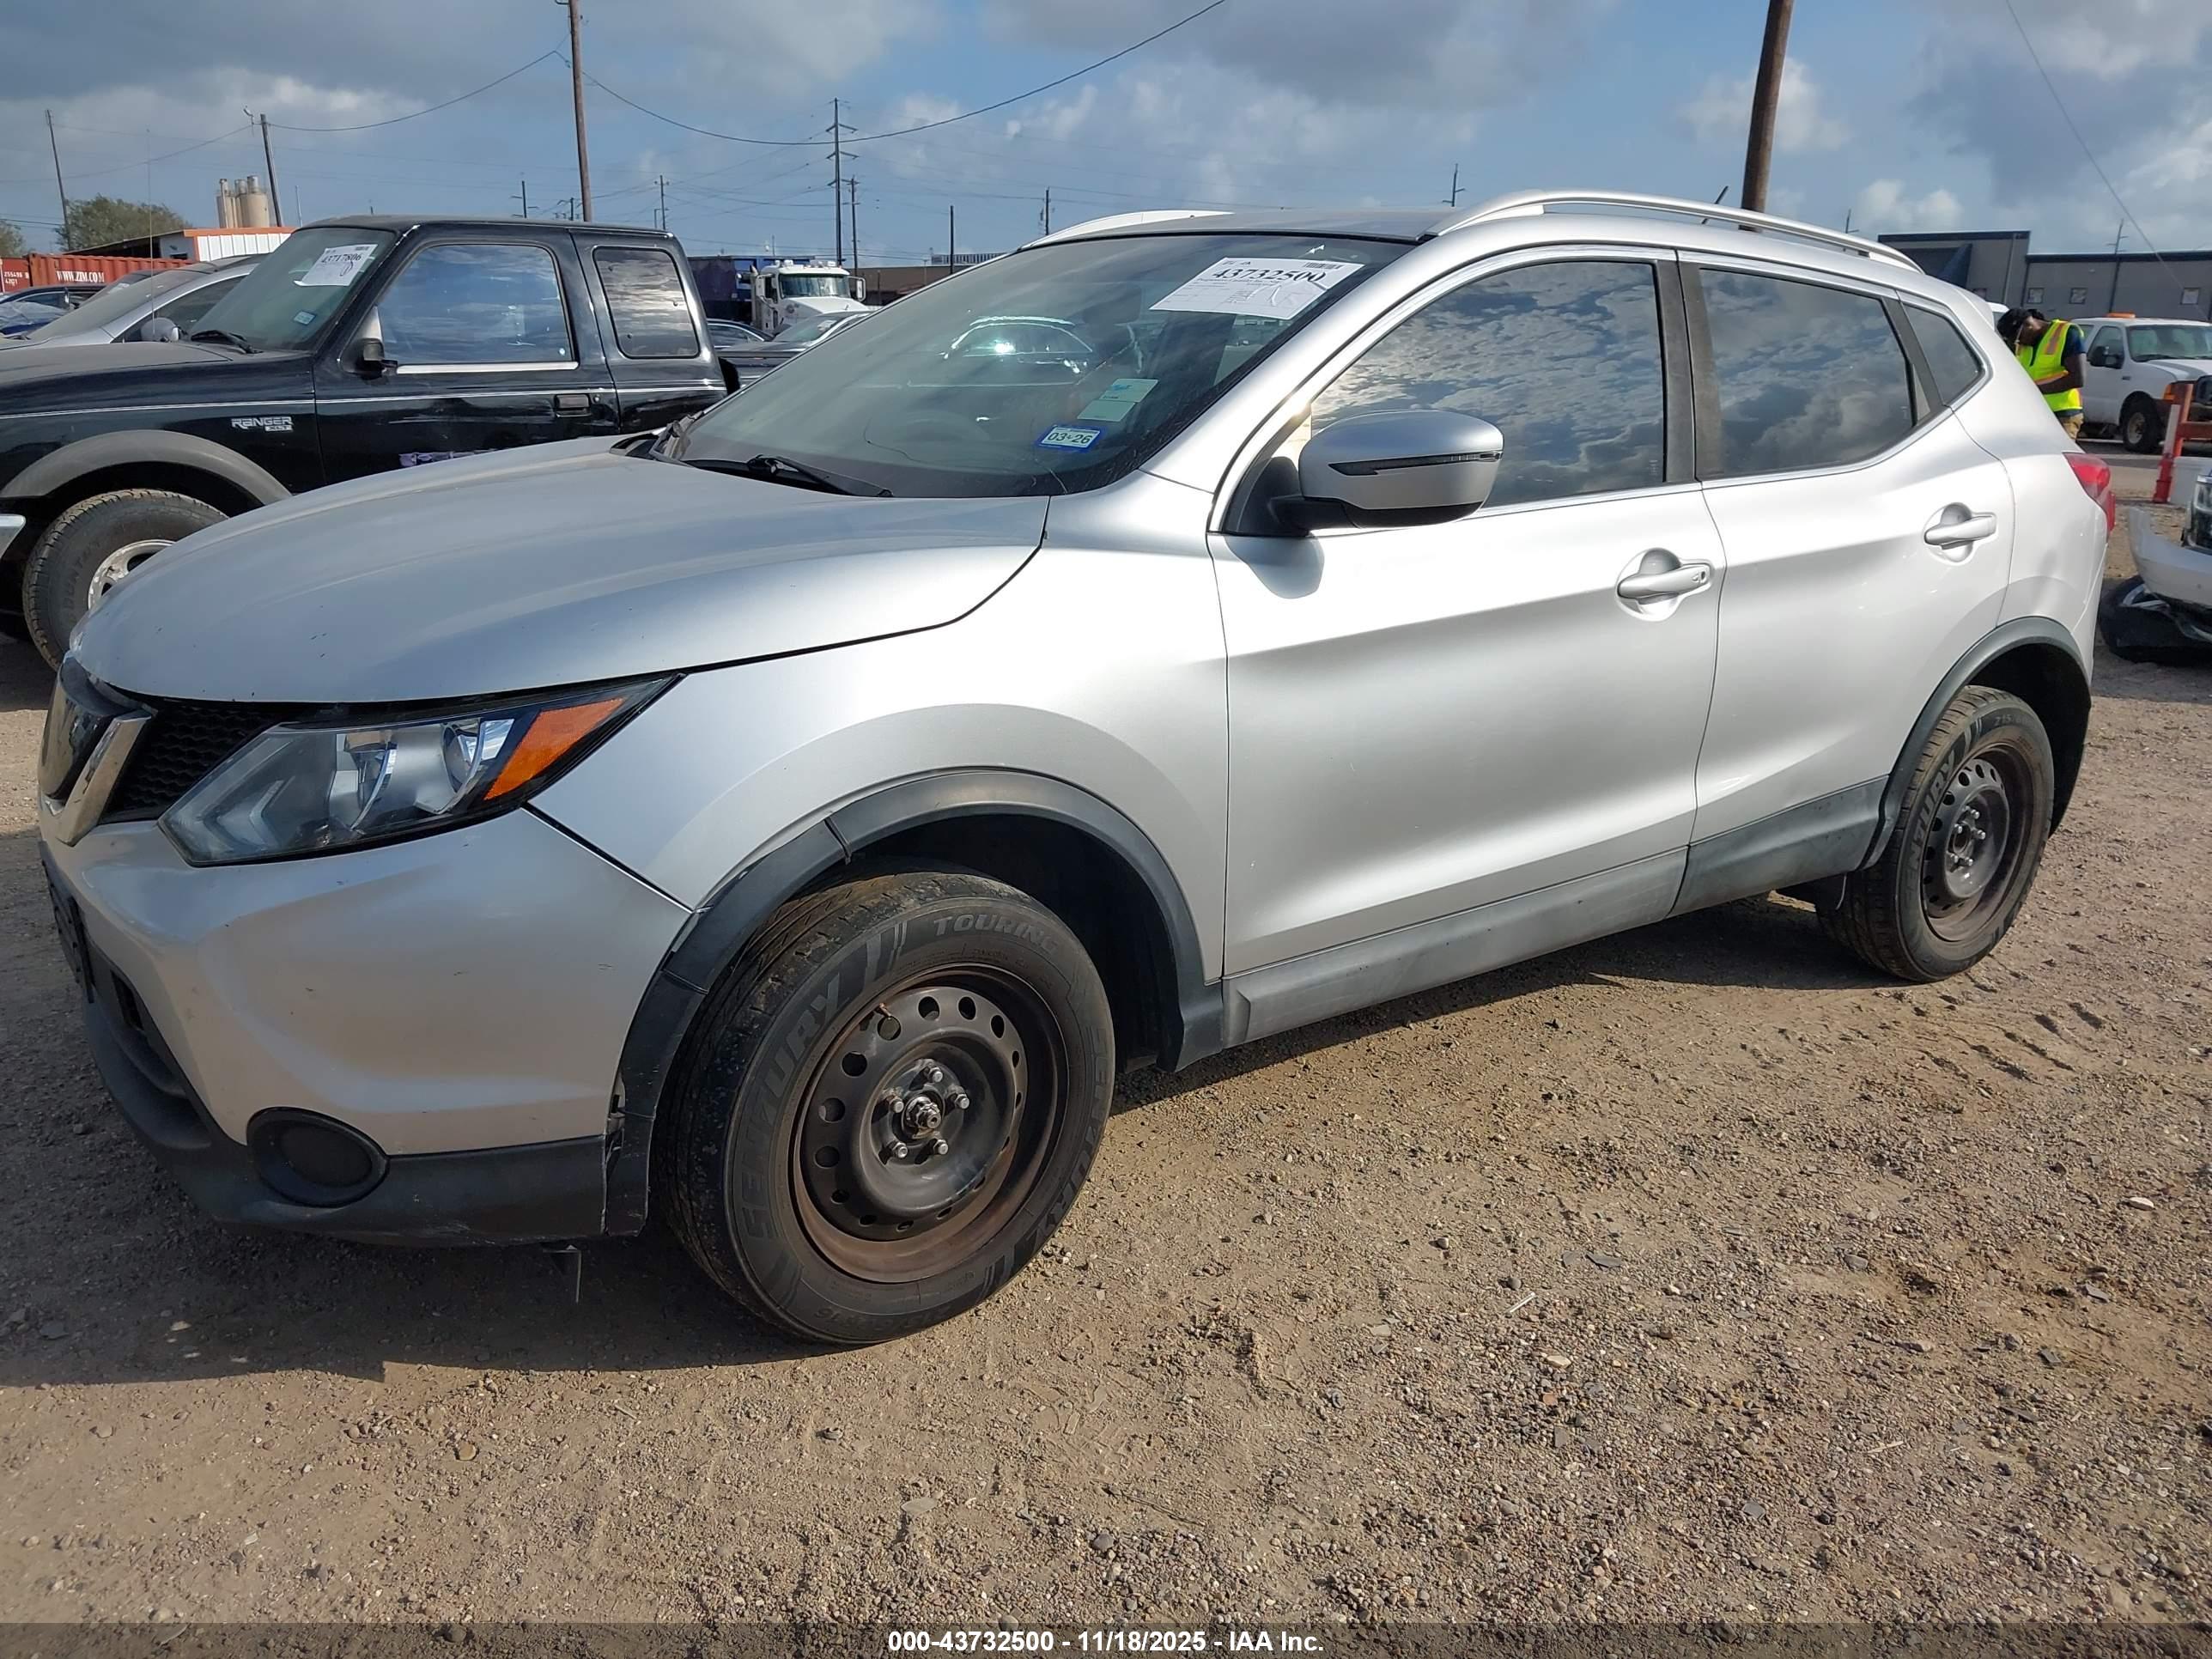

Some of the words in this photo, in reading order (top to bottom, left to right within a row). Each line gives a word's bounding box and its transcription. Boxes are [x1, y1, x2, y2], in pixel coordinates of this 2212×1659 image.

[56, 270, 105, 283] WWW.ZIM.COM
[1212, 267, 1327, 283] 43732500
[231, 416, 294, 429] RANGER
[933, 914, 1059, 955] TOURING
